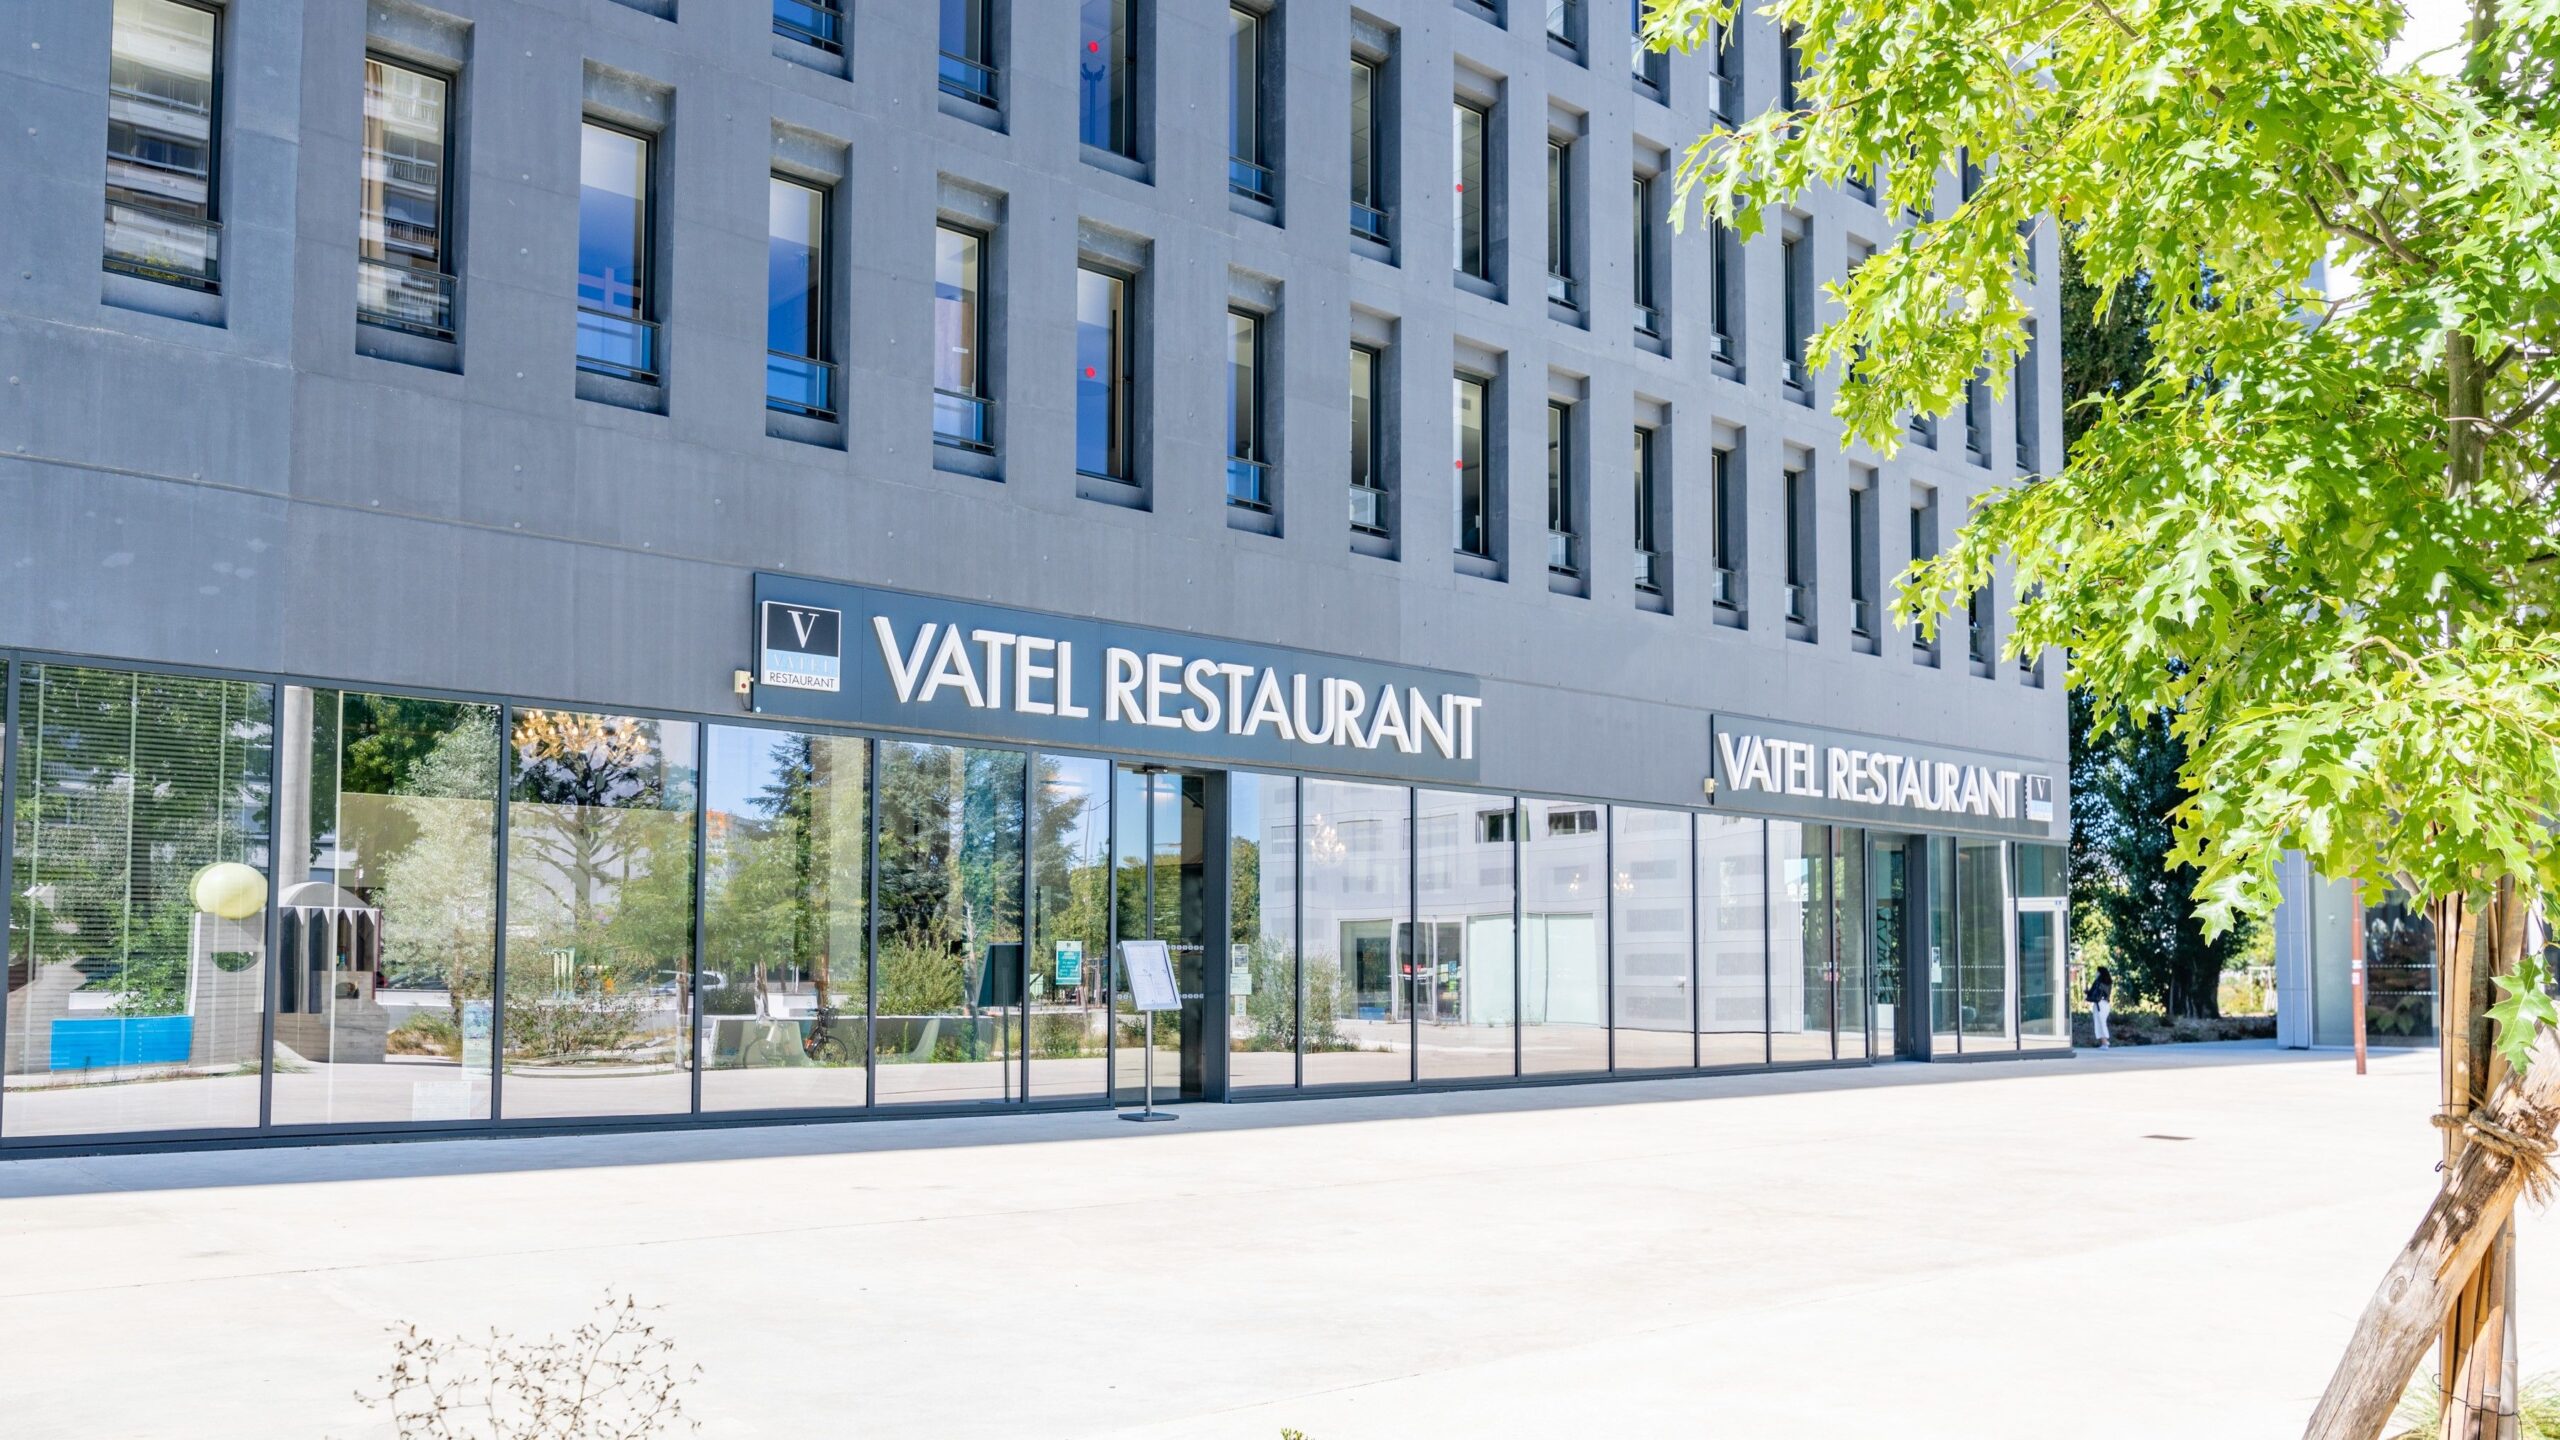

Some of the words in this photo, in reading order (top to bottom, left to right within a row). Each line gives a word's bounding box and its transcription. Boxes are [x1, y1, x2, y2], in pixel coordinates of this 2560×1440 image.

[787, 610, 820, 648] V
[769, 672, 835, 688] RESTAURANT
[873, 616, 1088, 718] VATEL
[1106, 647, 1482, 759] RESTAURANT
[1718, 733, 1823, 797] VATEL
[1828, 747, 2020, 819] RESTAURANT
[2036, 778, 2046, 800] V
